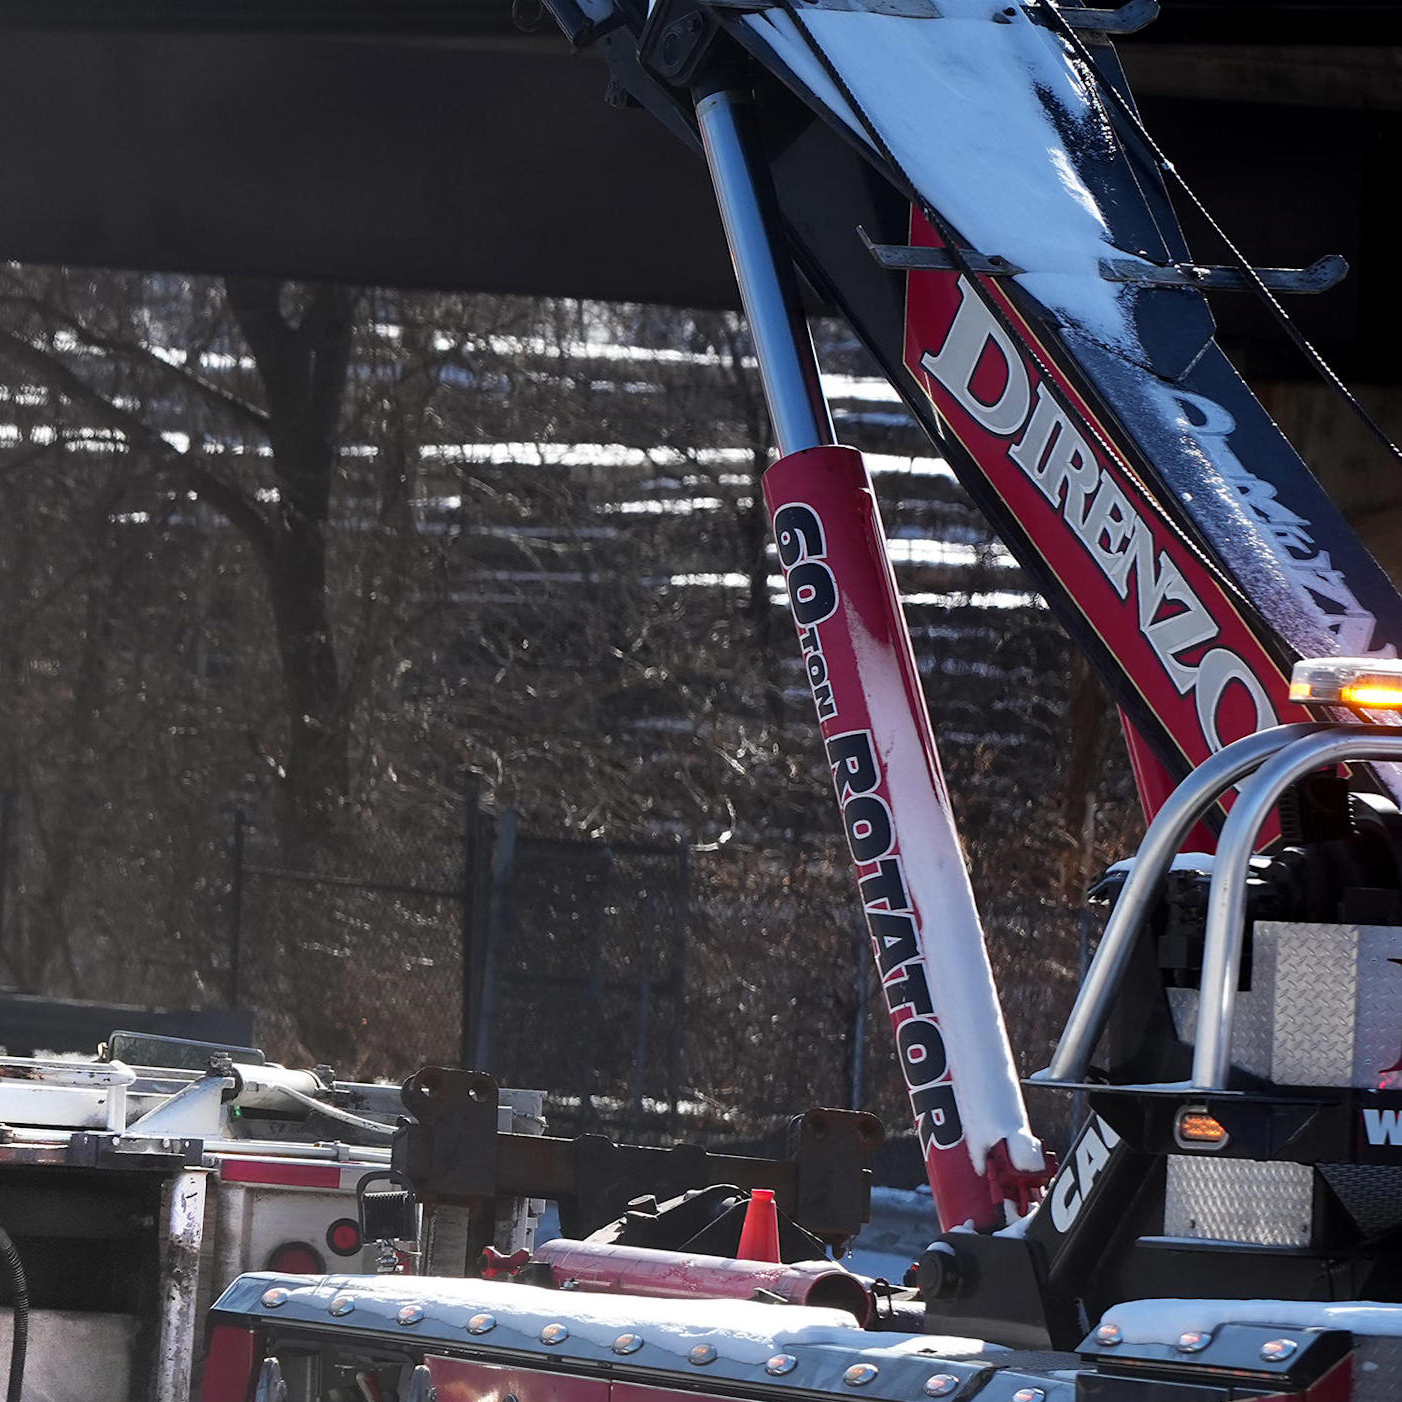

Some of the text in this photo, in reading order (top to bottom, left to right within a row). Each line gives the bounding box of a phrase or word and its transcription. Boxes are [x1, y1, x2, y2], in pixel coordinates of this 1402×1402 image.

[920, 274, 1281, 792] DIRENZO
[773, 502, 965, 1161] 60 TON ROTATOR
